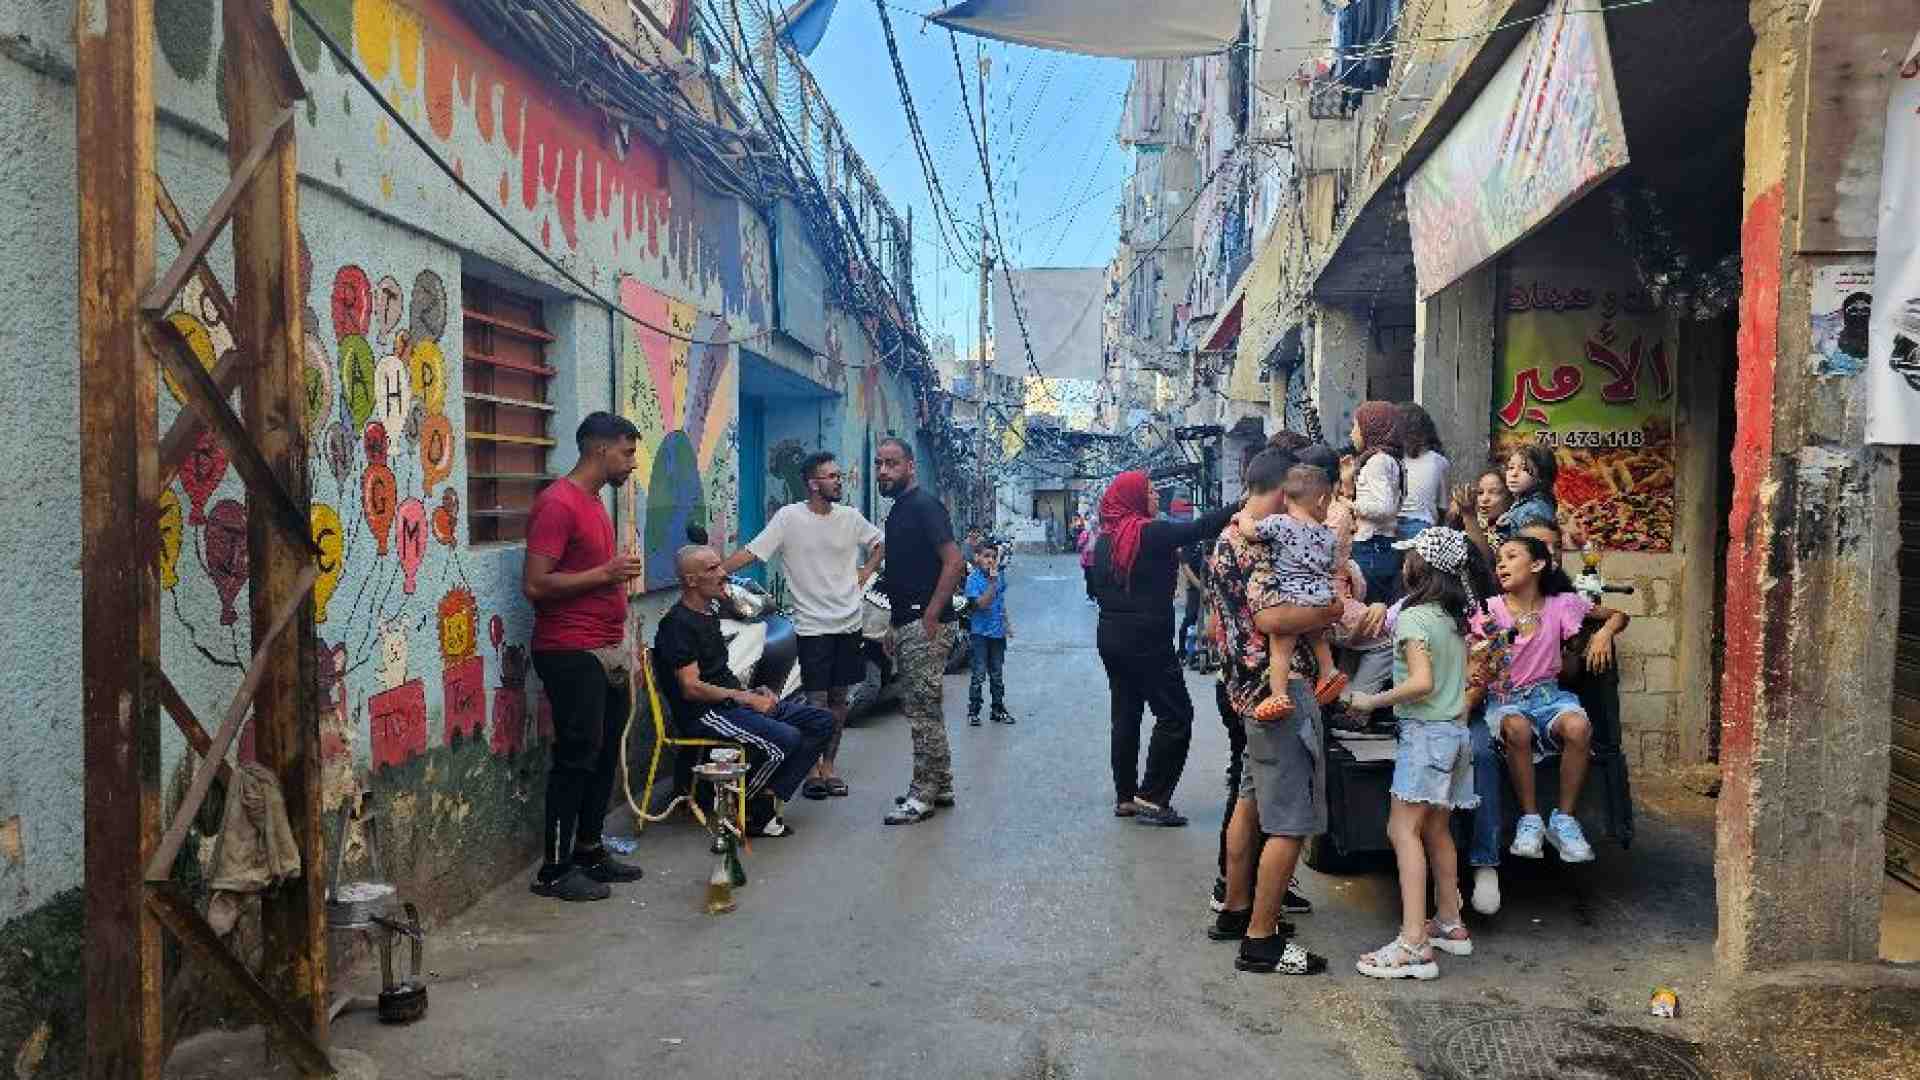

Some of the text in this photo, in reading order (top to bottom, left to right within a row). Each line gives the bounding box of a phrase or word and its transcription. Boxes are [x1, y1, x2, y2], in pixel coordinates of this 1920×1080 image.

[351, 351, 369, 406] A
[385, 369, 402, 417] H
[1498, 320, 1672, 427] الأمير
[1536, 431, 1642, 447] 71 473 118
[402, 516, 419, 561] M
